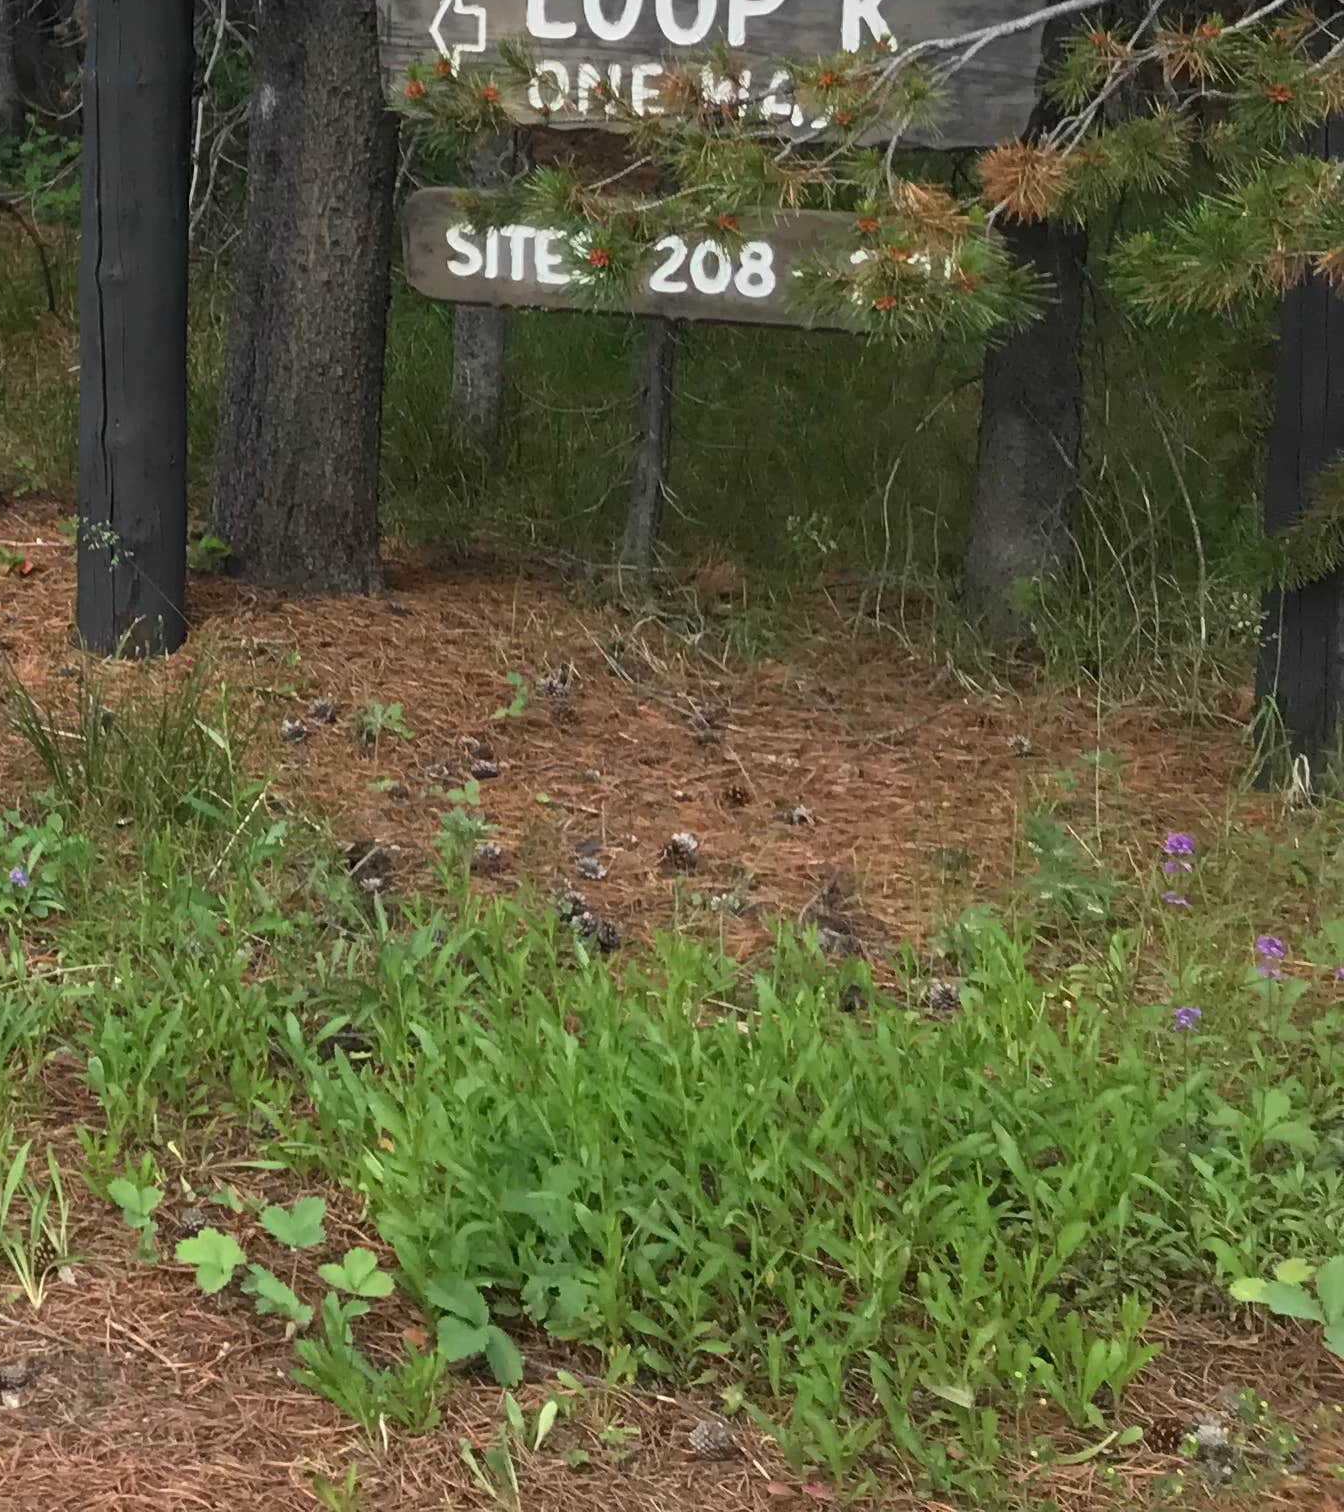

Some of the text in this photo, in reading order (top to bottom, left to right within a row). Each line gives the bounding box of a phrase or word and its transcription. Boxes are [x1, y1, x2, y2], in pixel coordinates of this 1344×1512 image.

[528, 56, 838, 130] ONE WA
[649, 235, 777, 298] 208
